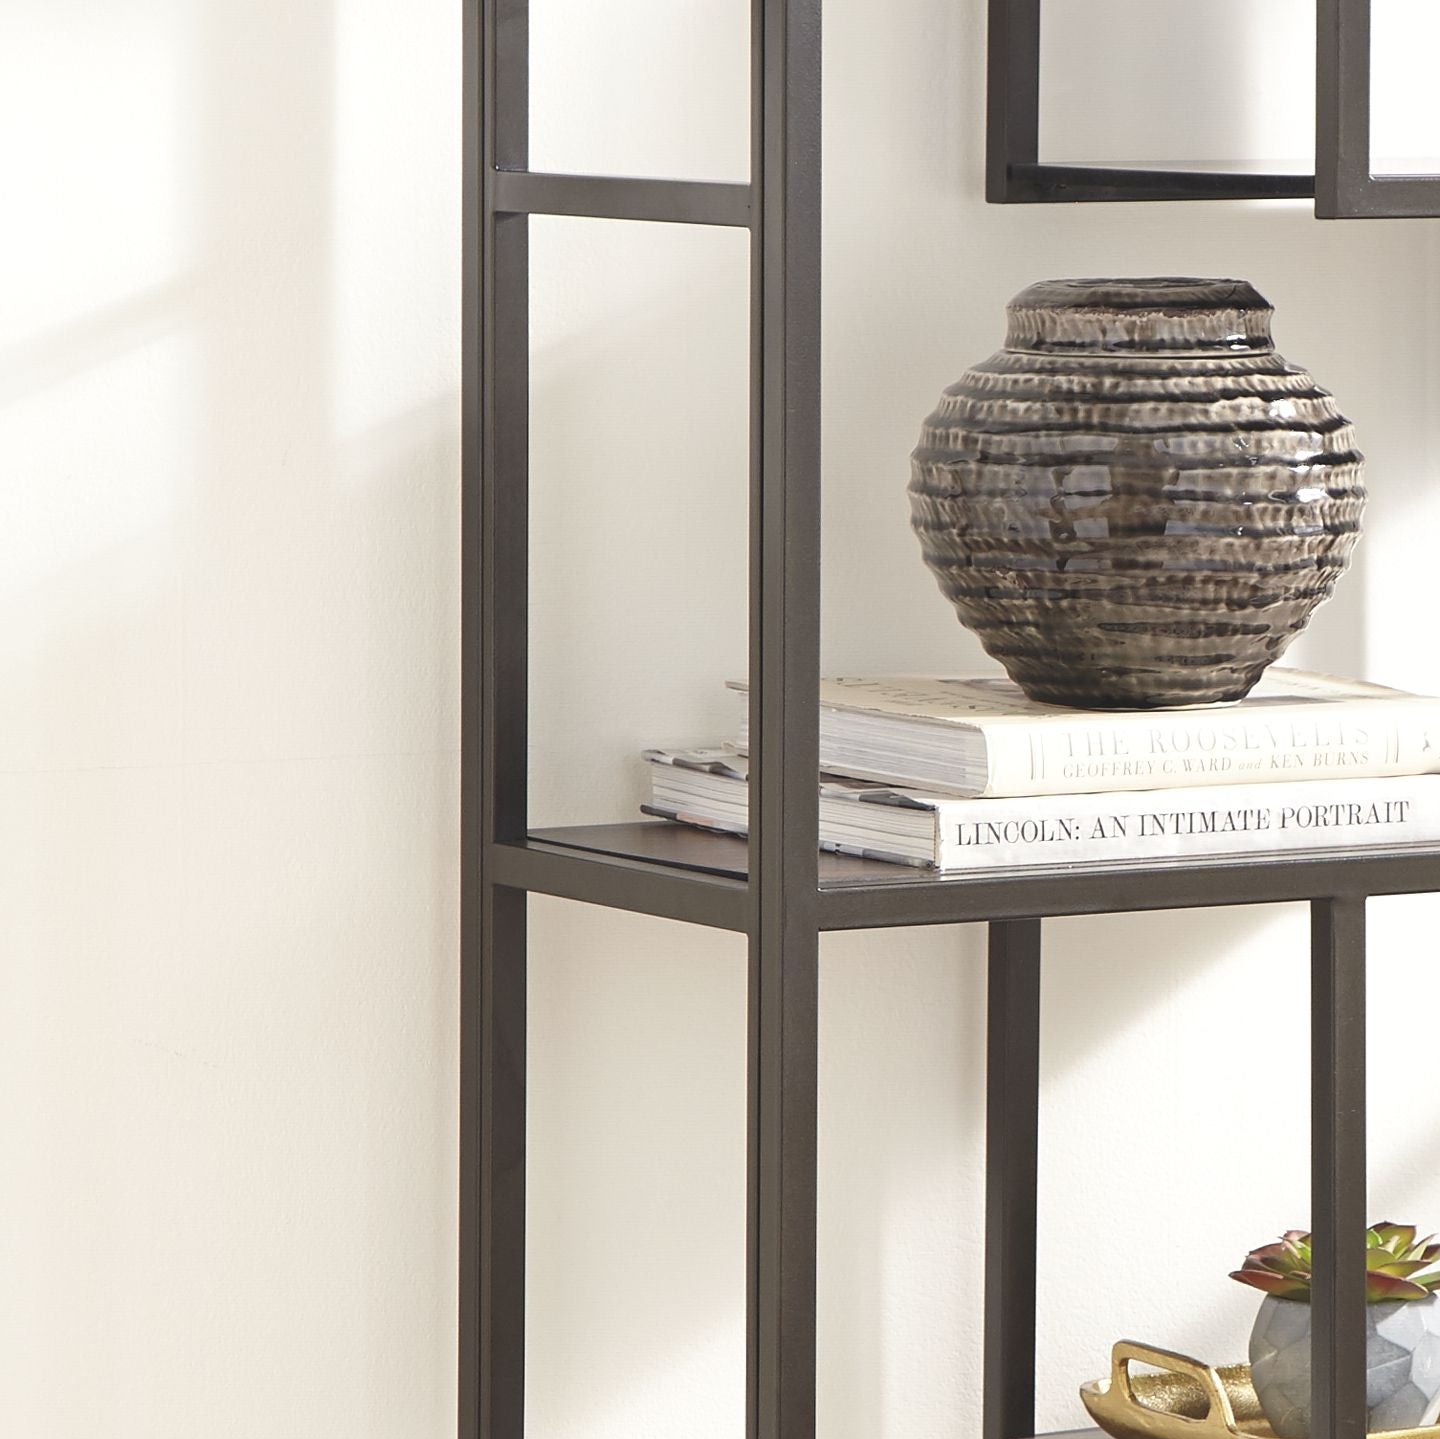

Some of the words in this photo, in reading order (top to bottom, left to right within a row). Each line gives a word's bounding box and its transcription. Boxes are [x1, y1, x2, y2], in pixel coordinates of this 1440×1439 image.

[1063, 728, 1130, 757] THE
[1148, 720, 1369, 755] ROOSEVELTS
[1063, 759, 1155, 779] GEOFFREY
[1162, 758, 1177, 774] C.
[1183, 756, 1233, 773] WARD
[1238, 758, 1262, 770] and
[1270, 753, 1305, 769] KEN
[1312, 750, 1369, 767] BURNS
[955, 817, 1081, 847] LINCOLN:
[1089, 814, 1129, 839] AN
[1138, 807, 1271, 837] INTIMATE
[1280, 800, 1410, 830] PORTRAIT
